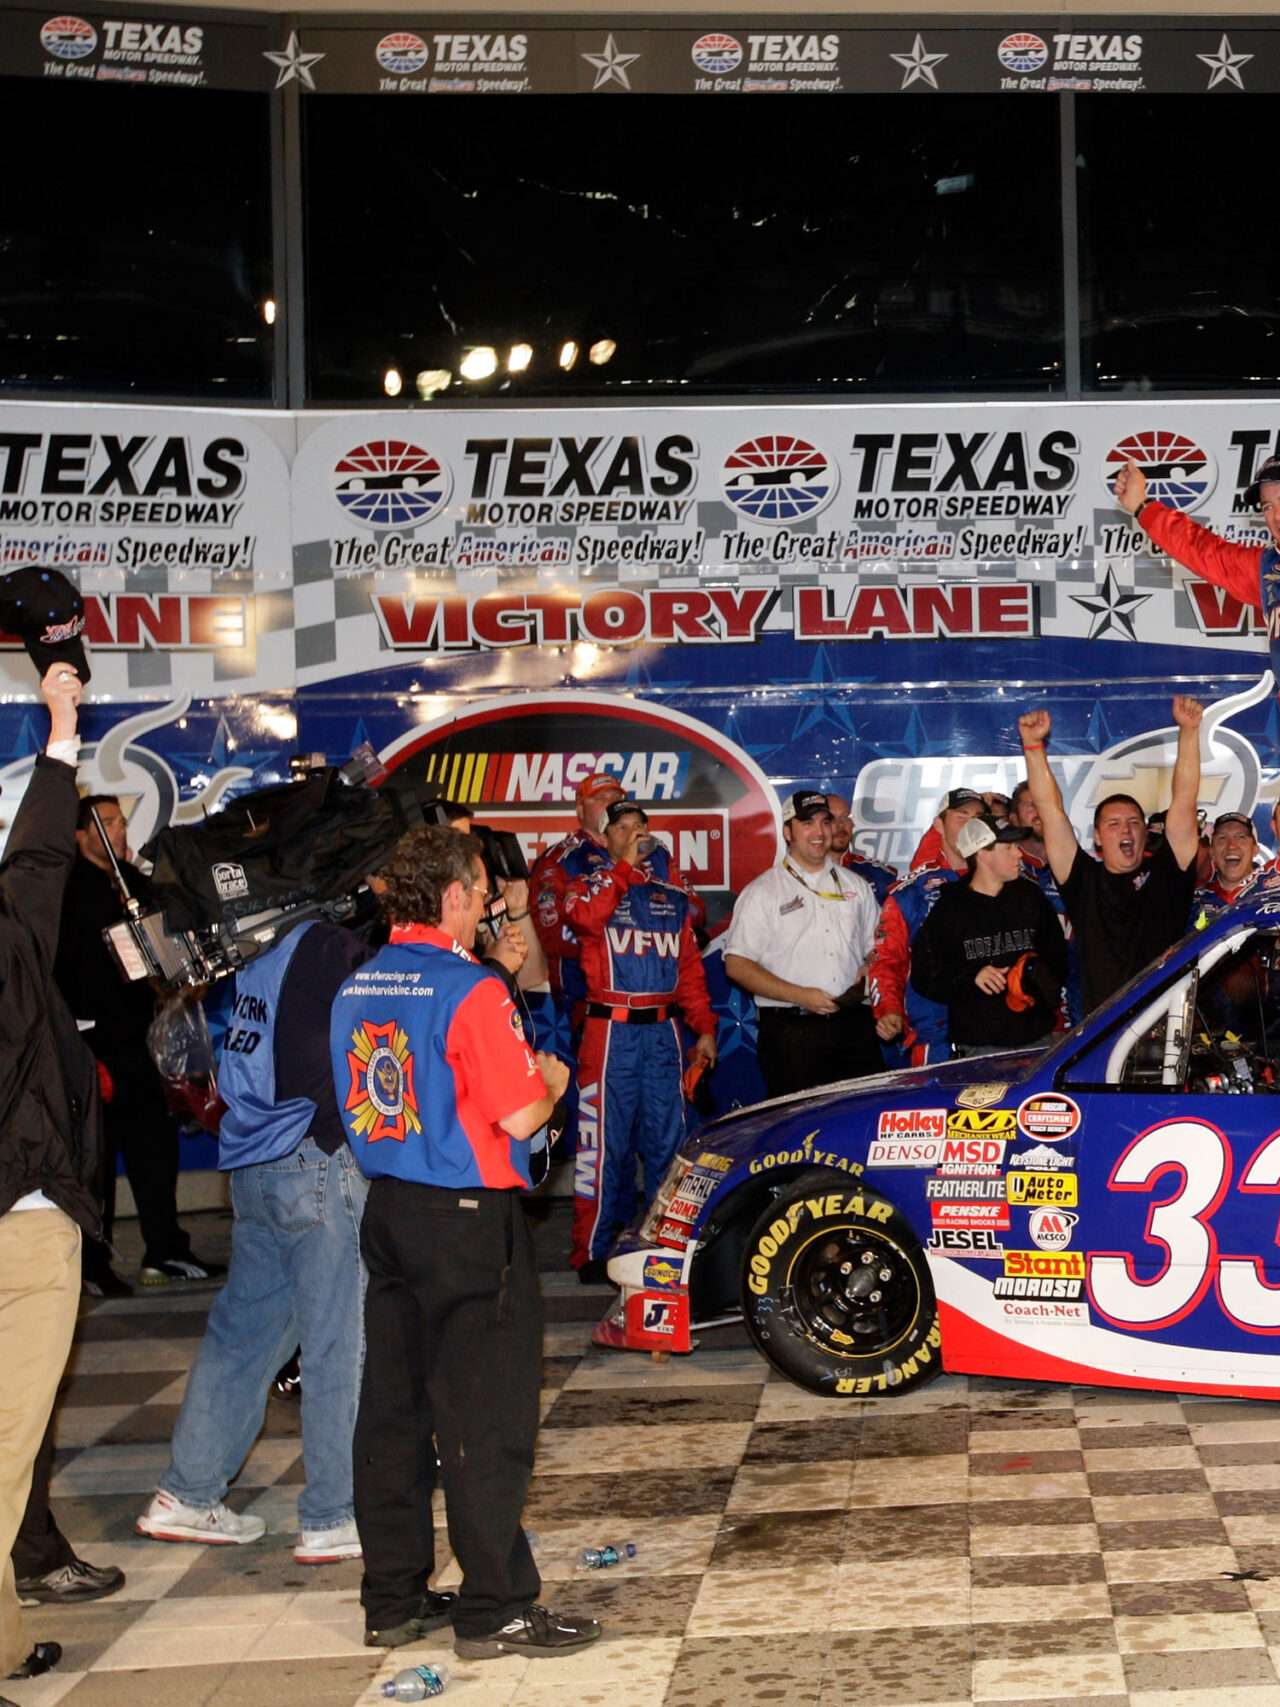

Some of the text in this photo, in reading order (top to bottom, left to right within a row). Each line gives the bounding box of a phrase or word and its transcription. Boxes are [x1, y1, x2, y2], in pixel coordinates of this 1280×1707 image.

[103, 21, 203, 54] TEXAS
[104, 50, 199, 64] MOTOR SPEEDWAY
[433, 35, 527, 61] TEXAS
[748, 35, 839, 61] TEXAS
[1053, 35, 1143, 61] TEXAS
[435, 63, 524, 72] MOTOR SPEEDWAY
[748, 63, 835, 72] MOTOR SPEEDWAY
[1053, 62, 1138, 71] MOTOR SPEEDWAY
[380, 79, 397, 90] The
[400, 79, 427, 90] Great
[477, 78, 528, 92] Speedway!
[1001, 78, 1017, 89] The
[1020, 78, 1046, 89] Great
[1093, 78, 1142, 91] Speedway!
[0, 433, 245, 498] TEXAS
[465, 435, 693, 498] TEXAS
[852, 430, 1077, 492] TEXAS
[0, 501, 235, 523] MOTOR SPEEDWAY
[467, 501, 692, 523] MOTOR SPEEDWAY
[854, 495, 1071, 518] MOTOR SPEEDWAY
[335, 531, 702, 566] The Great American Speedway!
[723, 526, 1082, 560] The Great American Speedway!
[1104, 526, 1141, 551] The
[0, 535, 251, 567] merican Speedway!
[372, 584, 1033, 648] VICTORY LANE
[504, 752, 680, 802] NASCAR
[609, 927, 681, 959] VFW
[355, 972, 420, 982] www.vfwracing.org
[1041, 1103, 1067, 1111] NASCAR
[881, 1112, 944, 1137] Holley
[1027, 1115, 1070, 1123] CRAFTSMAN
[574, 1082, 599, 1199] VFW
[947, 1128, 1016, 1139] MECHANIX WEAR
[697, 1152, 734, 1171] MOOG
[749, 1148, 865, 1177] GOODYEAR
[872, 1144, 937, 1161] DENSO
[943, 1142, 1001, 1163] MSD
[1010, 1154, 1075, 1167] KEYSTONE LIGHT
[941, 1164, 997, 1175] IGNITION
[927, 1180, 1006, 1197] FEATHERLITE
[1028, 1176, 1064, 1188] Auto
[1026, 1189, 1072, 1201] Meter
[669, 1199, 699, 1218] COMP
[939, 1206, 1000, 1217] PENSKE
[748, 1194, 894, 1296] GOODYEAR
[929, 1231, 1000, 1249] JESEL
[644, 1267, 680, 1280] SUNOCO
[1007, 1252, 1080, 1275] Stant
[994, 1278, 1081, 1298] MOROSO
[1004, 1303, 1080, 1317] Coach-Net
